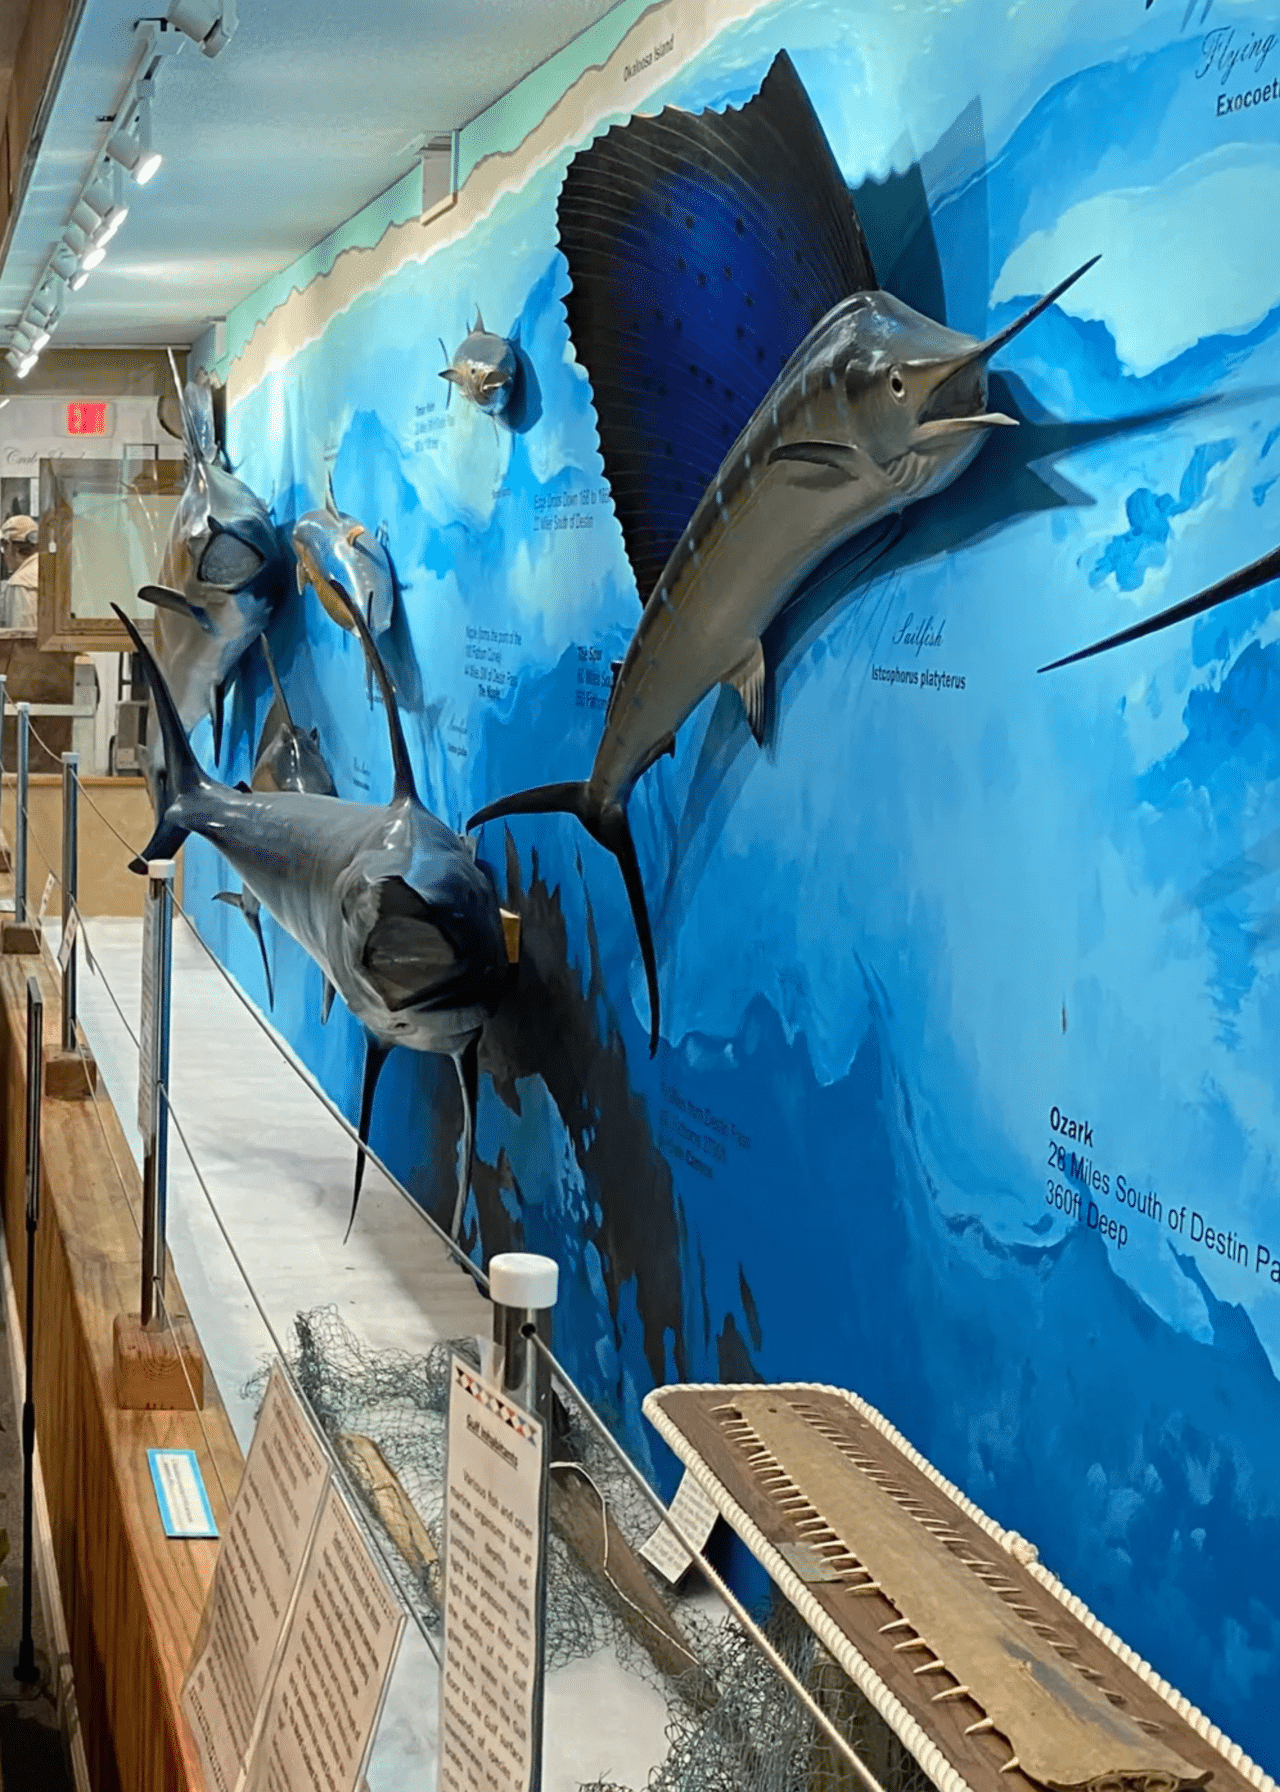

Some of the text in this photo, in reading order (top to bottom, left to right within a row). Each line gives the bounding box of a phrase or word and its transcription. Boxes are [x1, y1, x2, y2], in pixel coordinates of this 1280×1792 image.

[623, 33, 674, 82] Okaloosa Island
[1195, 25, 1279, 85] Flying
[892, 612, 946, 657] Sailfish
[1050, 1106, 1093, 1148] Ozark
[1046, 1179, 1128, 1250] 360ft Deep
[1048, 1140, 1280, 1284] 28 Miles South of Destin Pa
[467, 1414, 480, 1433] Gulf
[500, 1505, 514, 1523] and
[514, 1518, 533, 1540] other
[509, 1537, 521, 1558] live
[466, 1571, 478, 1590] and
[466, 1645, 477, 1664] the
[480, 1663, 498, 1687] water
[486, 1644, 494, 1658] of
[498, 1654, 509, 1674] the
[512, 1670, 527, 1692] Gulf
[462, 1691, 469, 1706] to
[471, 1700, 482, 1720] the
[484, 1714, 498, 1737] Gulf
[499, 1705, 510, 1726] the
[512, 1719, 526, 1742] Gulf
[477, 1736, 485, 1750] of
